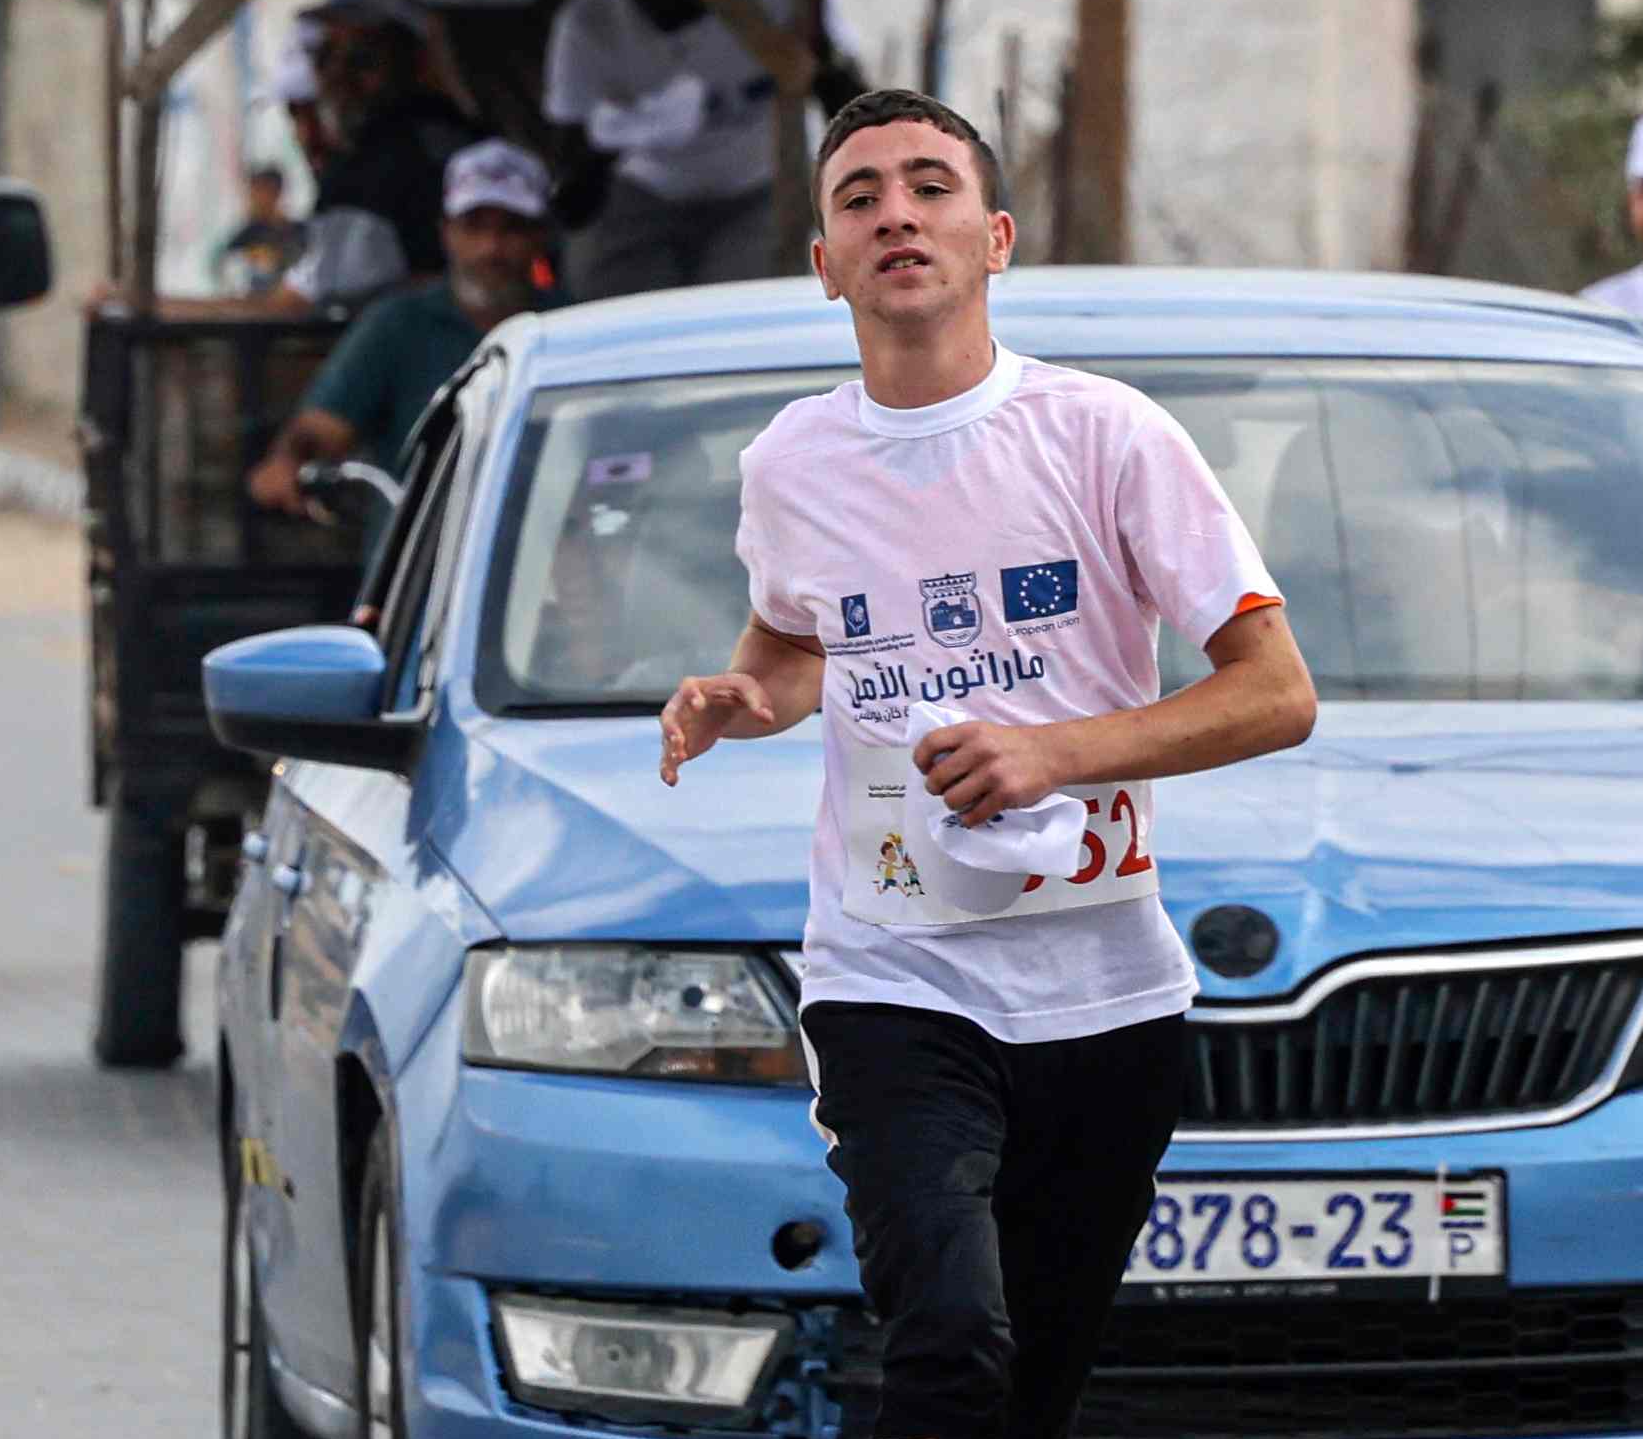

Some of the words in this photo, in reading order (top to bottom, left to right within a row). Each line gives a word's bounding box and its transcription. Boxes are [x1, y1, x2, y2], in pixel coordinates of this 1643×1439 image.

[1007, 622, 1055, 637] European
[1057, 616, 1081, 629] Union
[847, 662, 910, 709] الأمل
[921, 648, 1045, 702] ماراثون
[1125, 1192, 1414, 1271] 878-23
[1449, 1232, 1475, 1268] P
